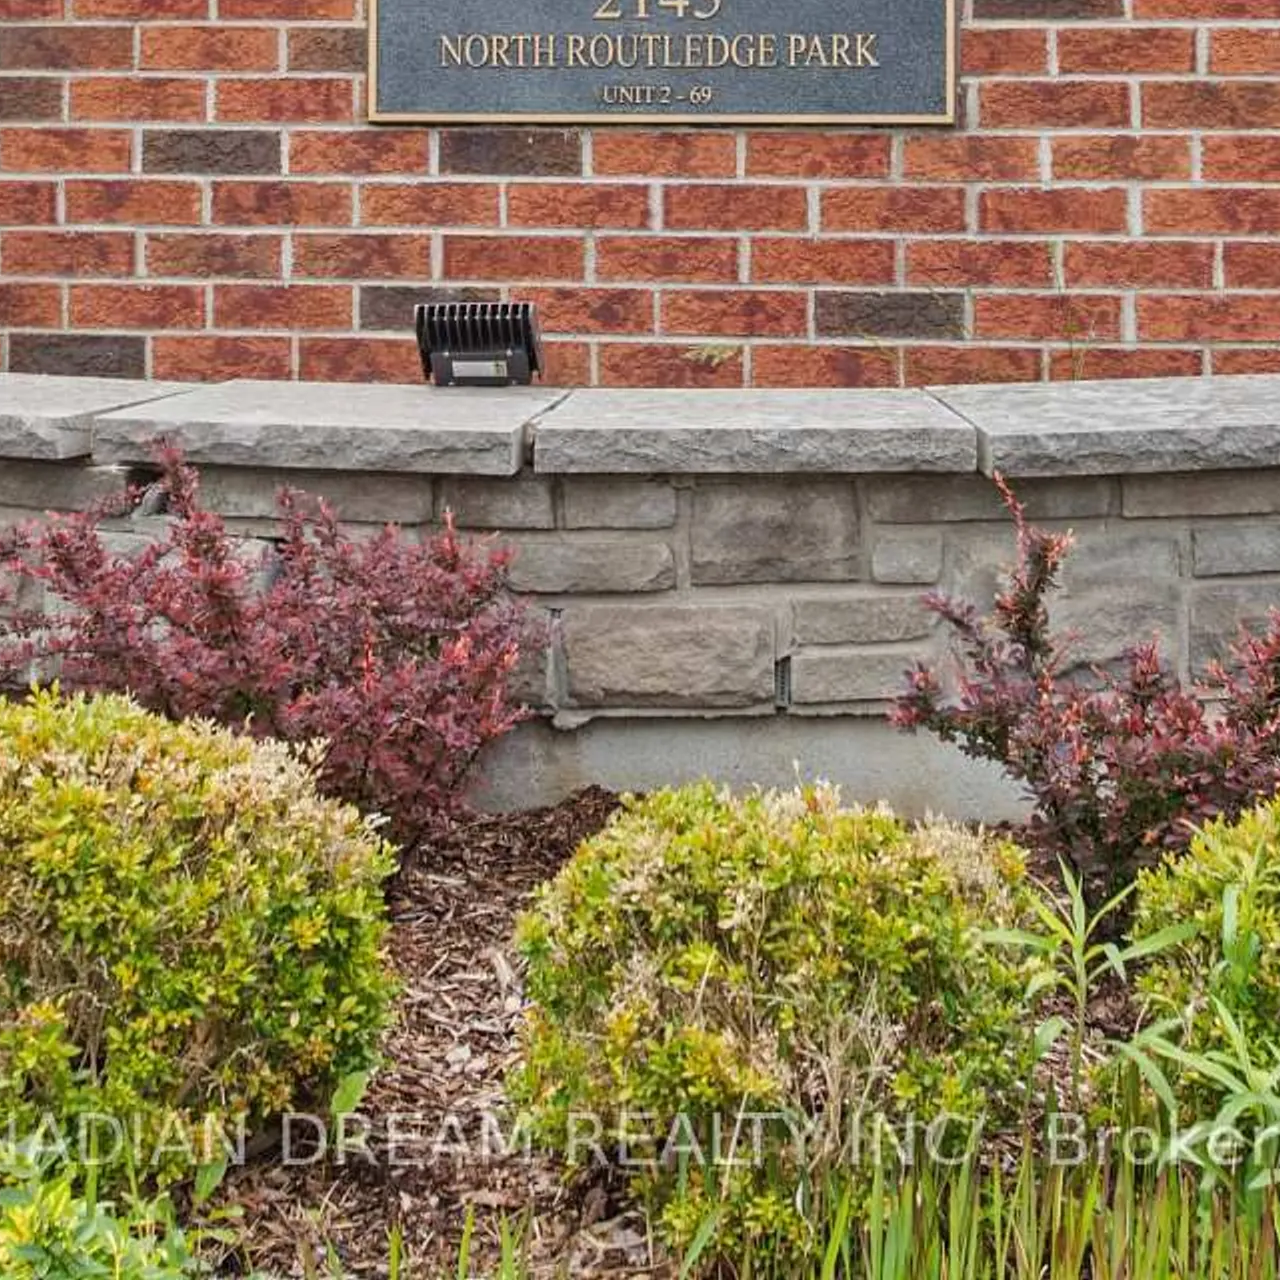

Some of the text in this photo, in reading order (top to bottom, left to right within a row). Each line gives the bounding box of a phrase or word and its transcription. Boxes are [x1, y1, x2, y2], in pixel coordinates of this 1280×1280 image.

[440, 33, 880, 68] NORTH ROUTLEDGE PARK
[603, 85, 655, 104] UNIT
[660, 85, 671, 103] 2
[690, 85, 712, 104] 69
